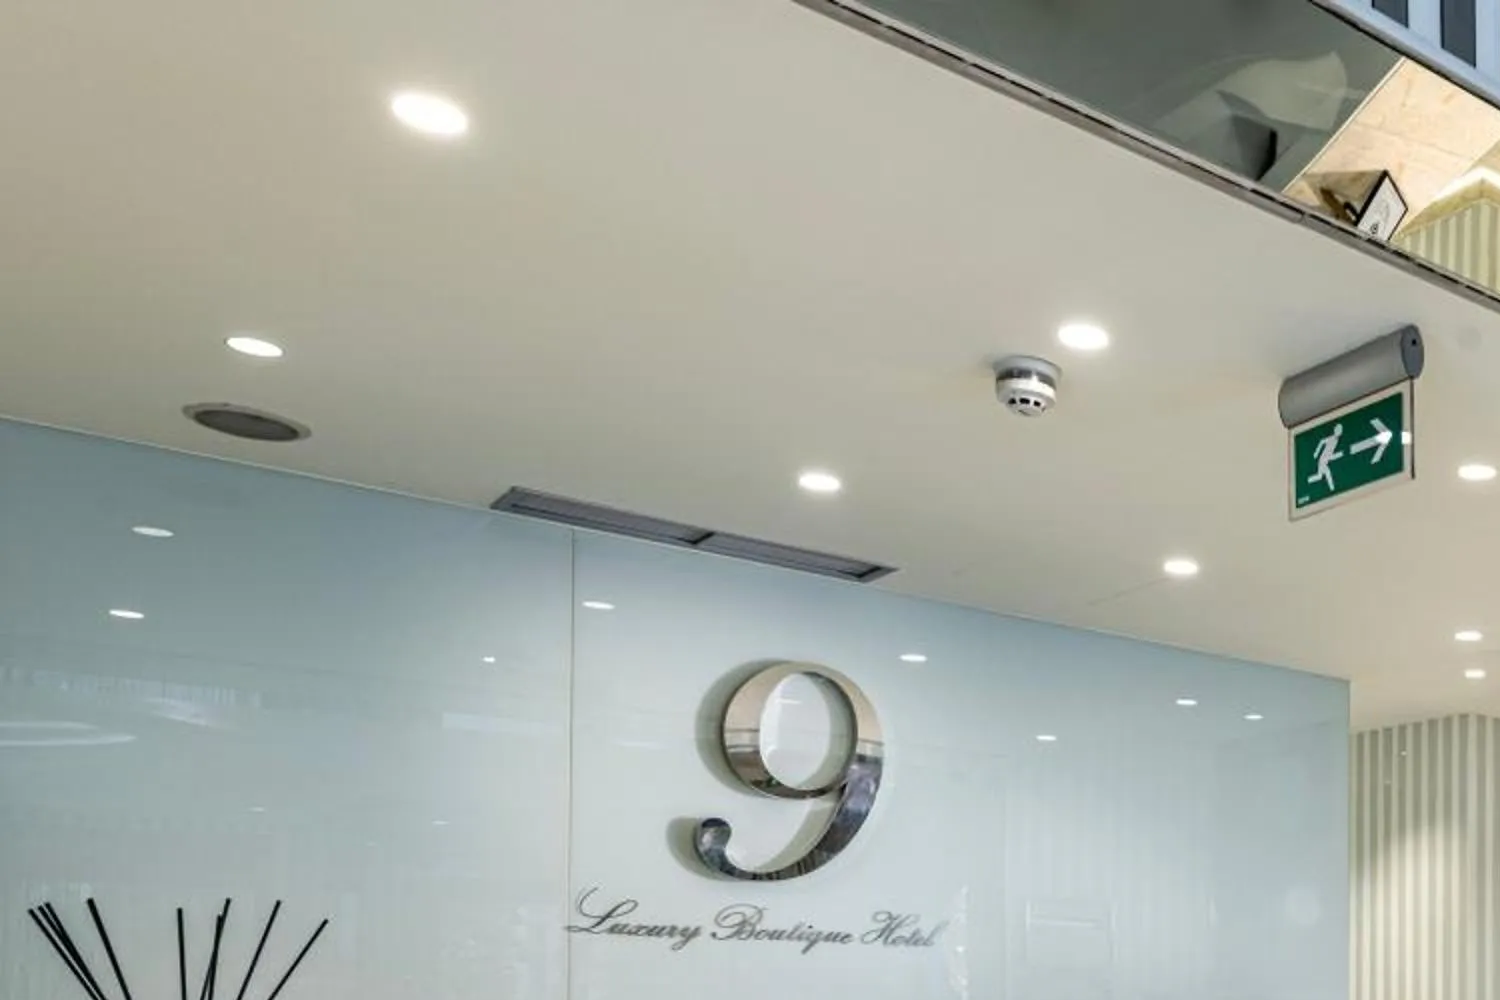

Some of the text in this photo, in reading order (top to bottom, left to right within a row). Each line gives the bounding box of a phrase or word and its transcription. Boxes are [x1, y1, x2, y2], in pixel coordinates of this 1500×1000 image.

[693, 662, 883, 882] 9
[566, 886, 946, 954] Luxury Boutique Hotel
